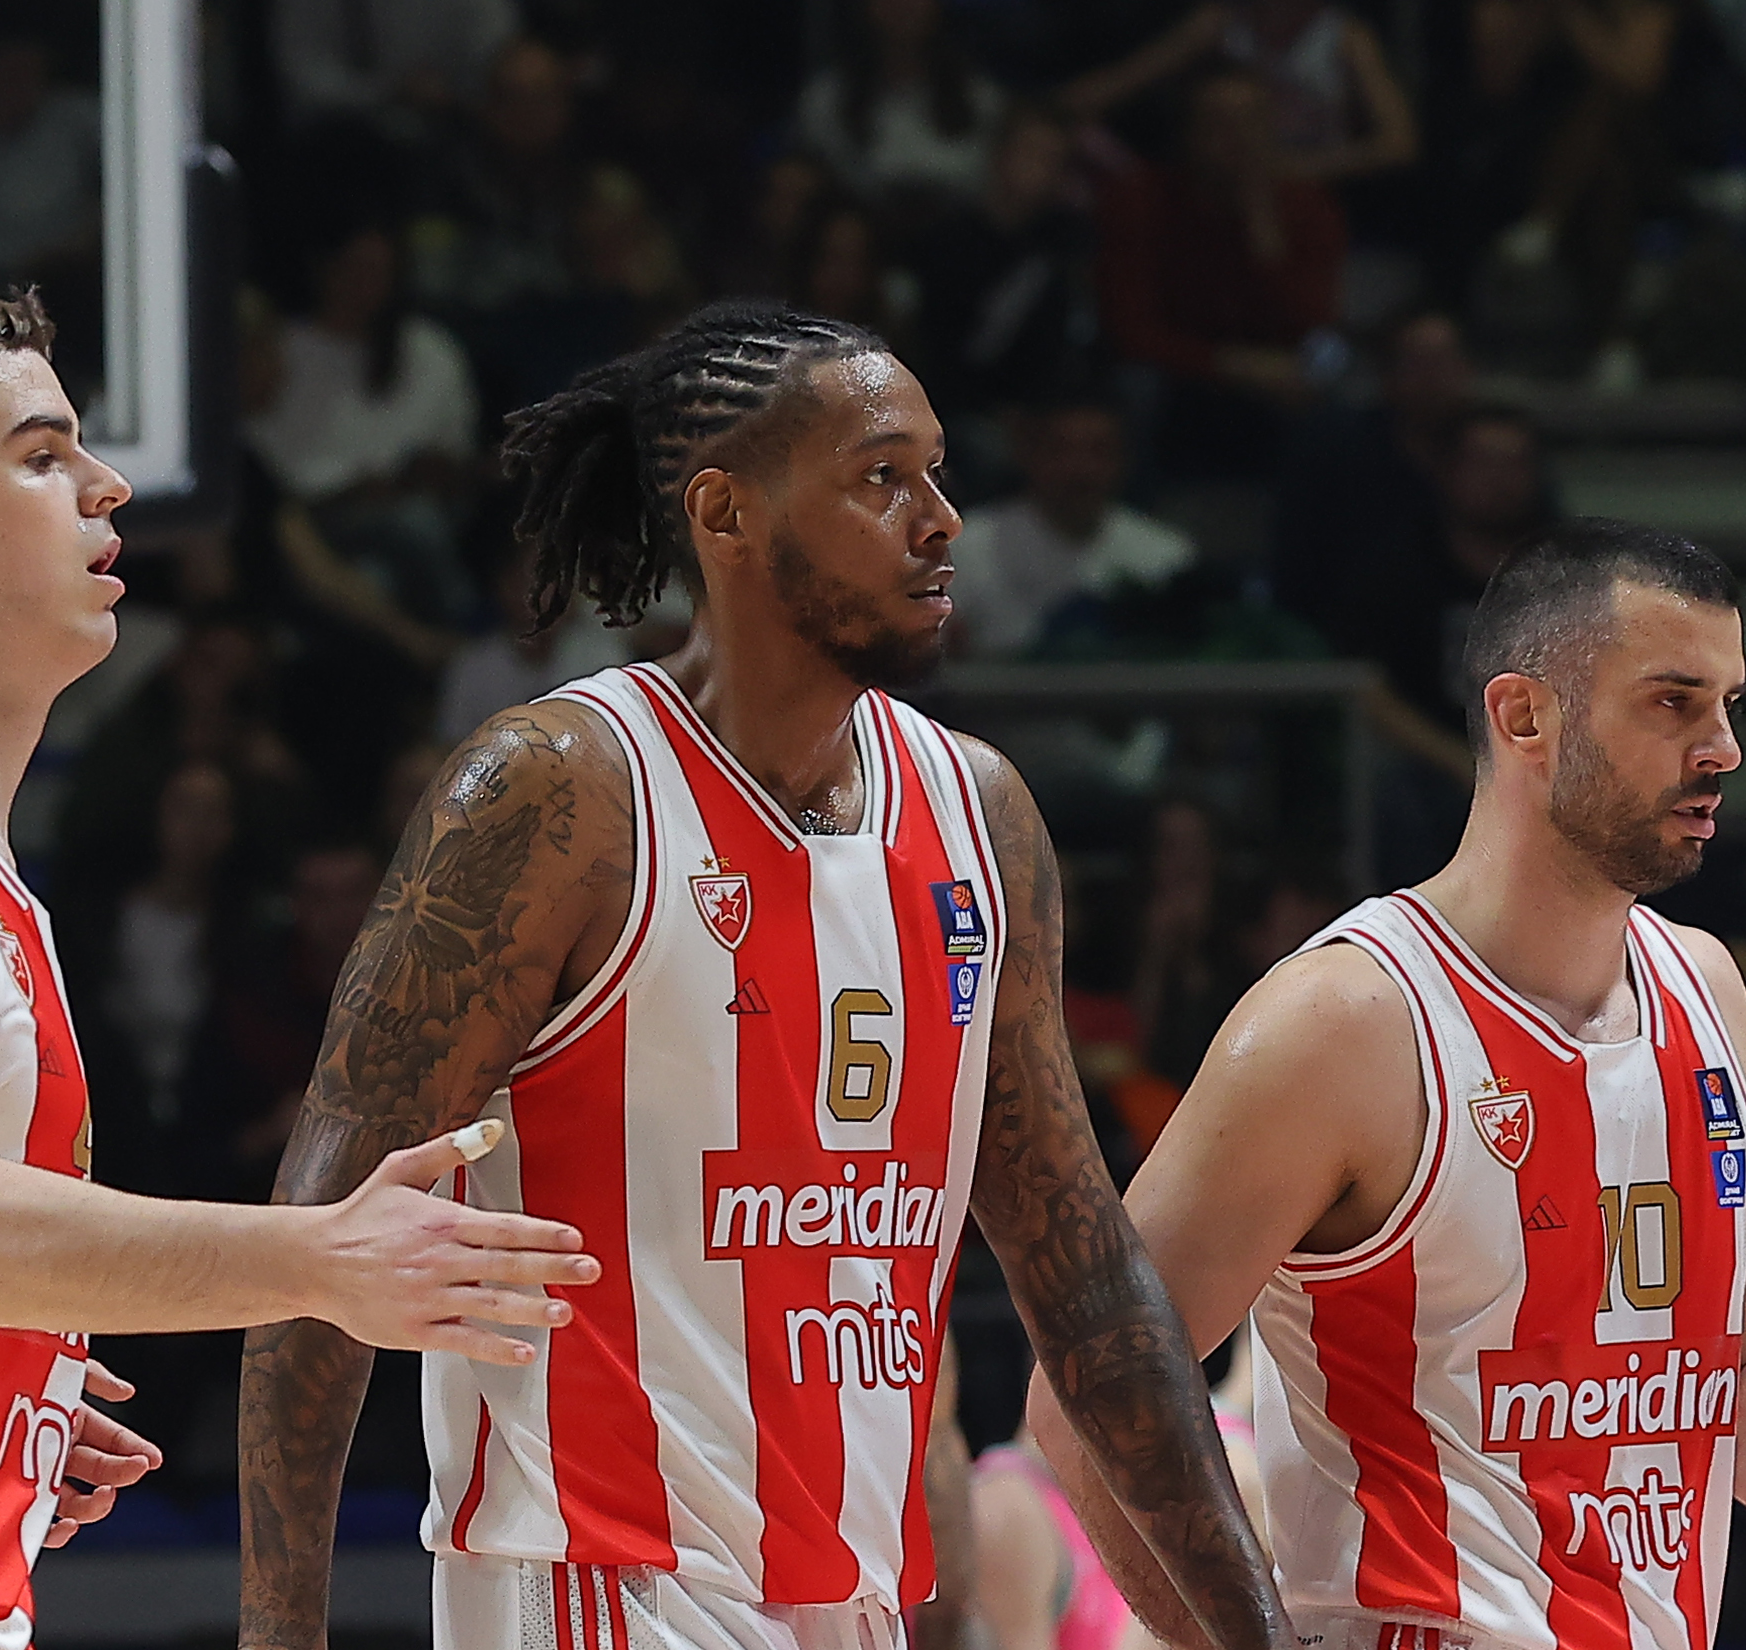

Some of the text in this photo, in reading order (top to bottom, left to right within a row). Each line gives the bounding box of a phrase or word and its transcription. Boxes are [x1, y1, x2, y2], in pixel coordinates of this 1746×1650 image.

[700, 885, 718, 896] KK
[948, 934, 985, 946] ADMIRAL
[826, 988, 893, 1123] 6
[1480, 1107, 1498, 1120] KK
[1597, 1182, 1682, 1312] 10
[786, 1288, 924, 1384] mts
